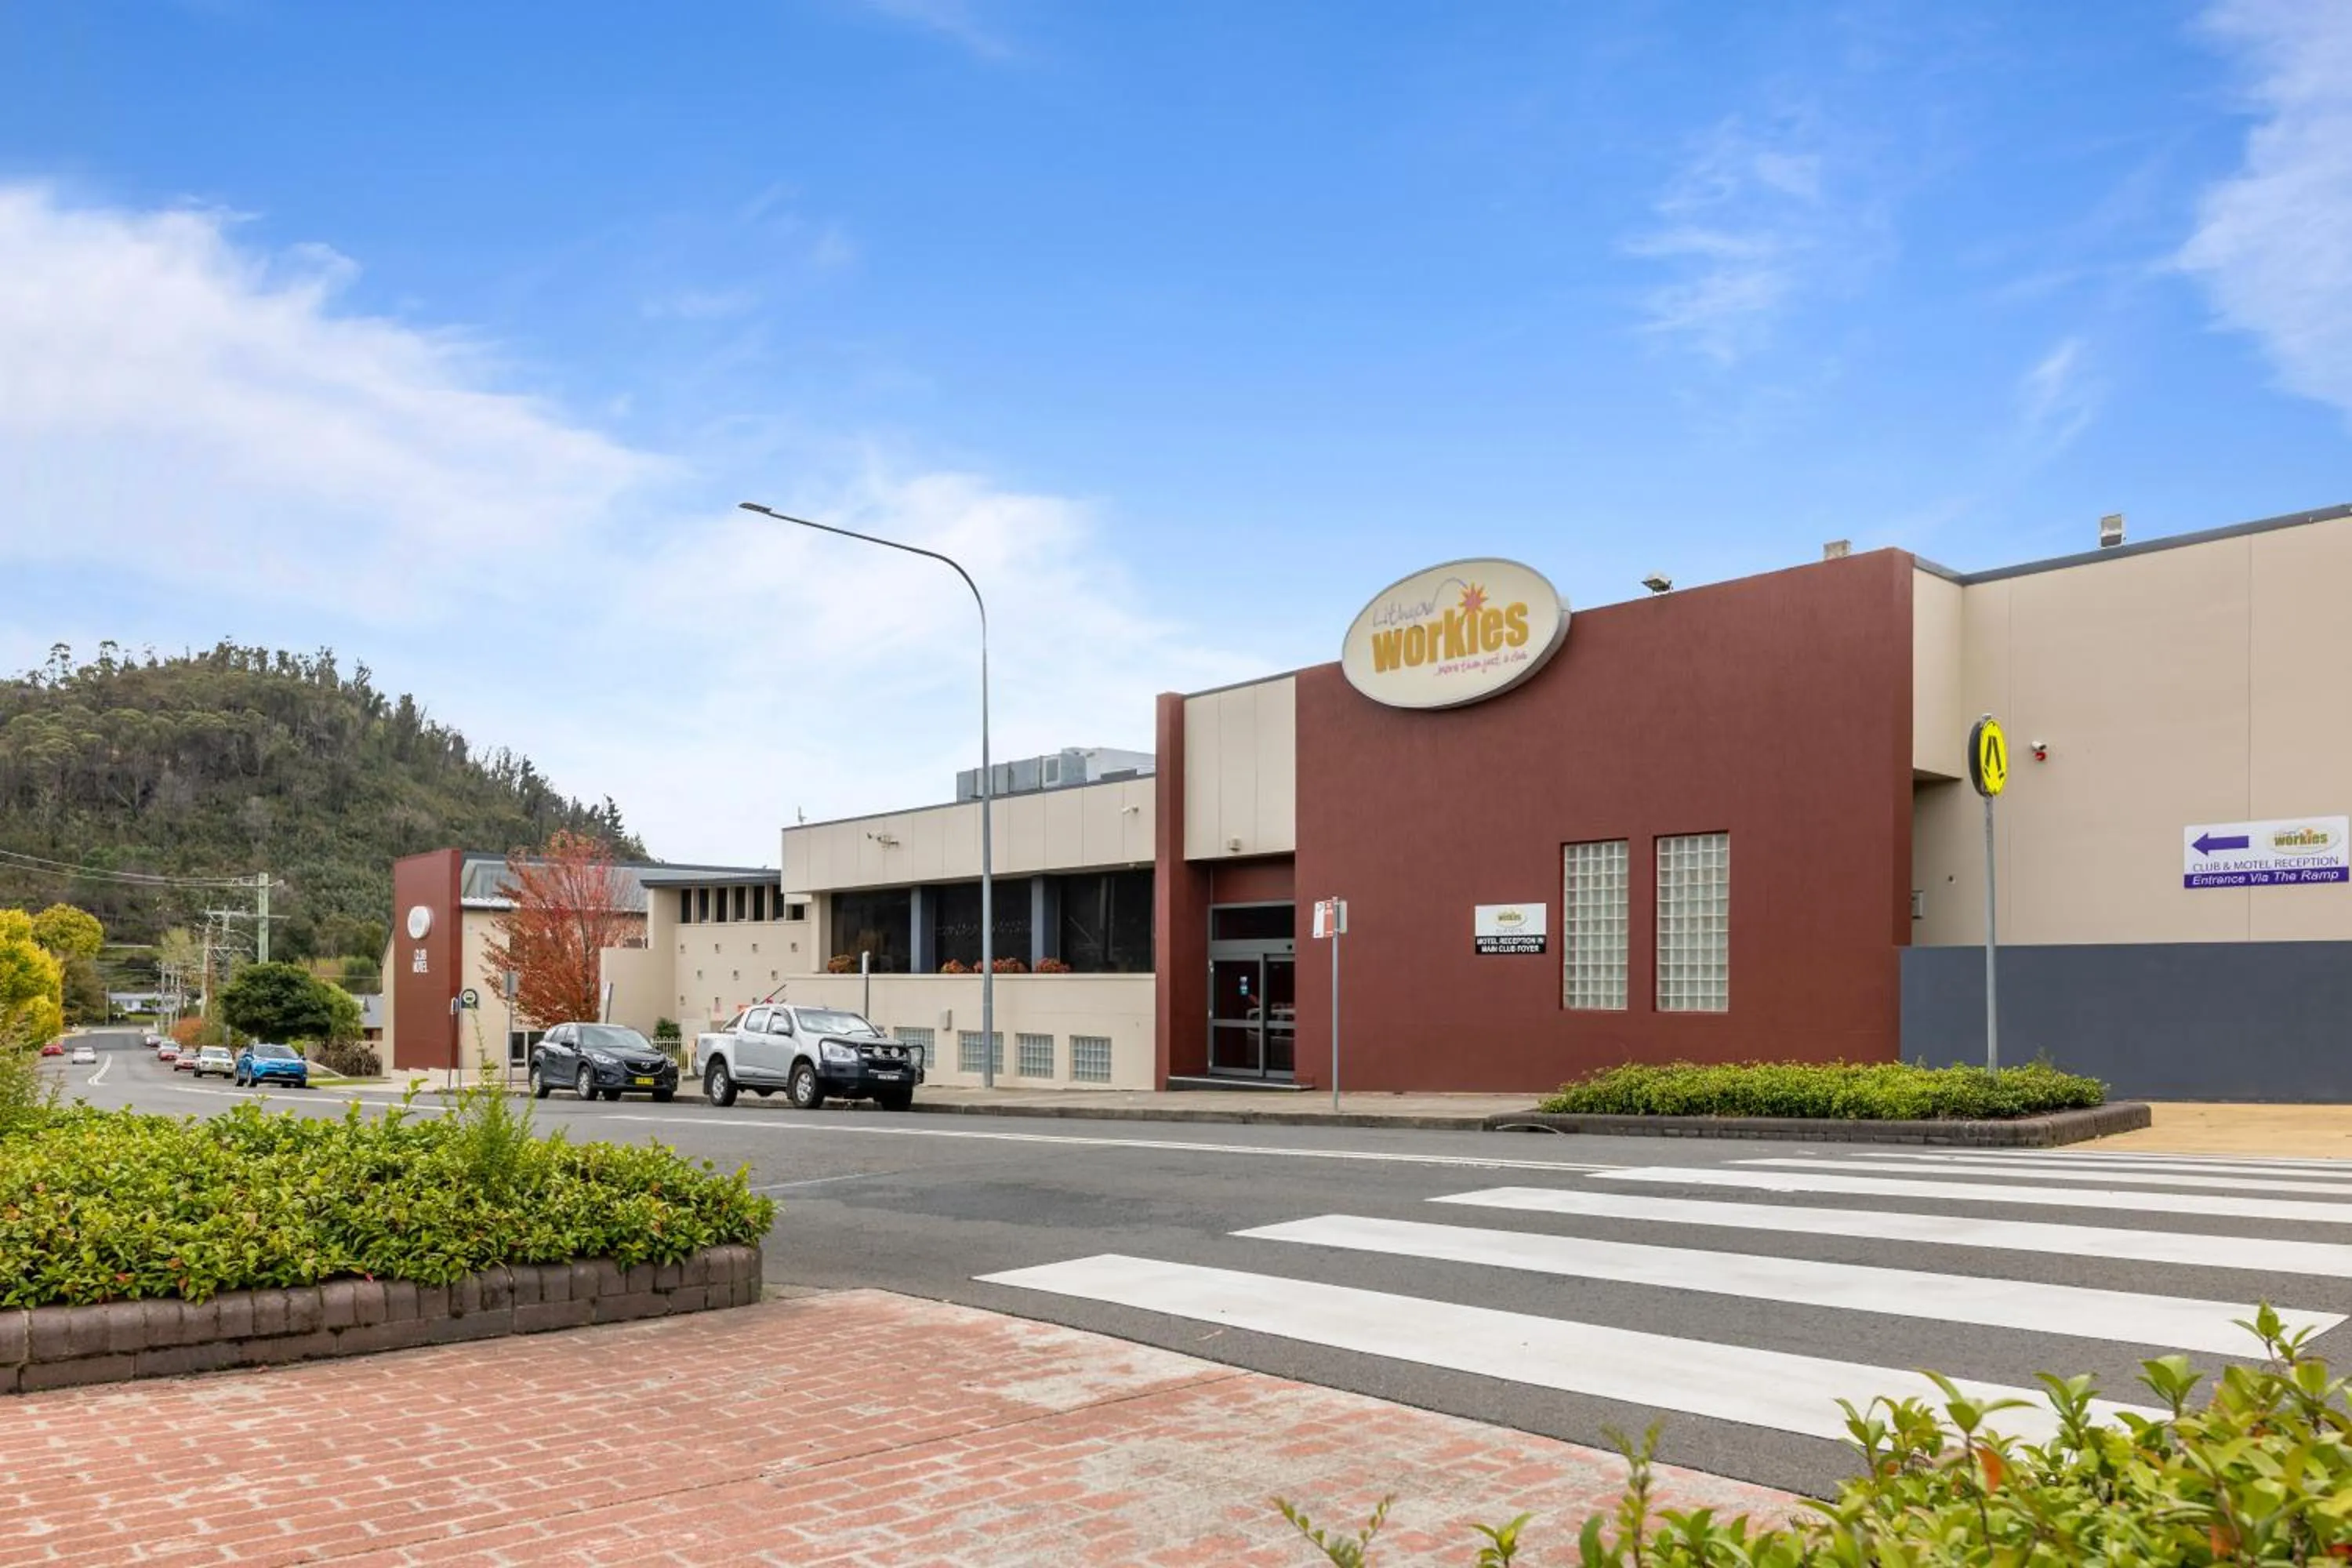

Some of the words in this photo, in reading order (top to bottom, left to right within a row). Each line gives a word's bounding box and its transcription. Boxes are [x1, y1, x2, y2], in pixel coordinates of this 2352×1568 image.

[1372, 601, 1529, 673] workies
[2274, 831, 2328, 846] workies
[2193, 862, 2220, 872] CLUB
[2223, 861, 2232, 870] &
[2234, 859, 2270, 870] MOTEL
[2274, 856, 2339, 868] RECEPTION
[2193, 873, 2245, 885] Entrance
[2249, 872, 2269, 884] Via
[2274, 871, 2296, 882] The
[2301, 869, 2339, 882] Ramp
[1499, 936, 1536, 945] RECEPTION
